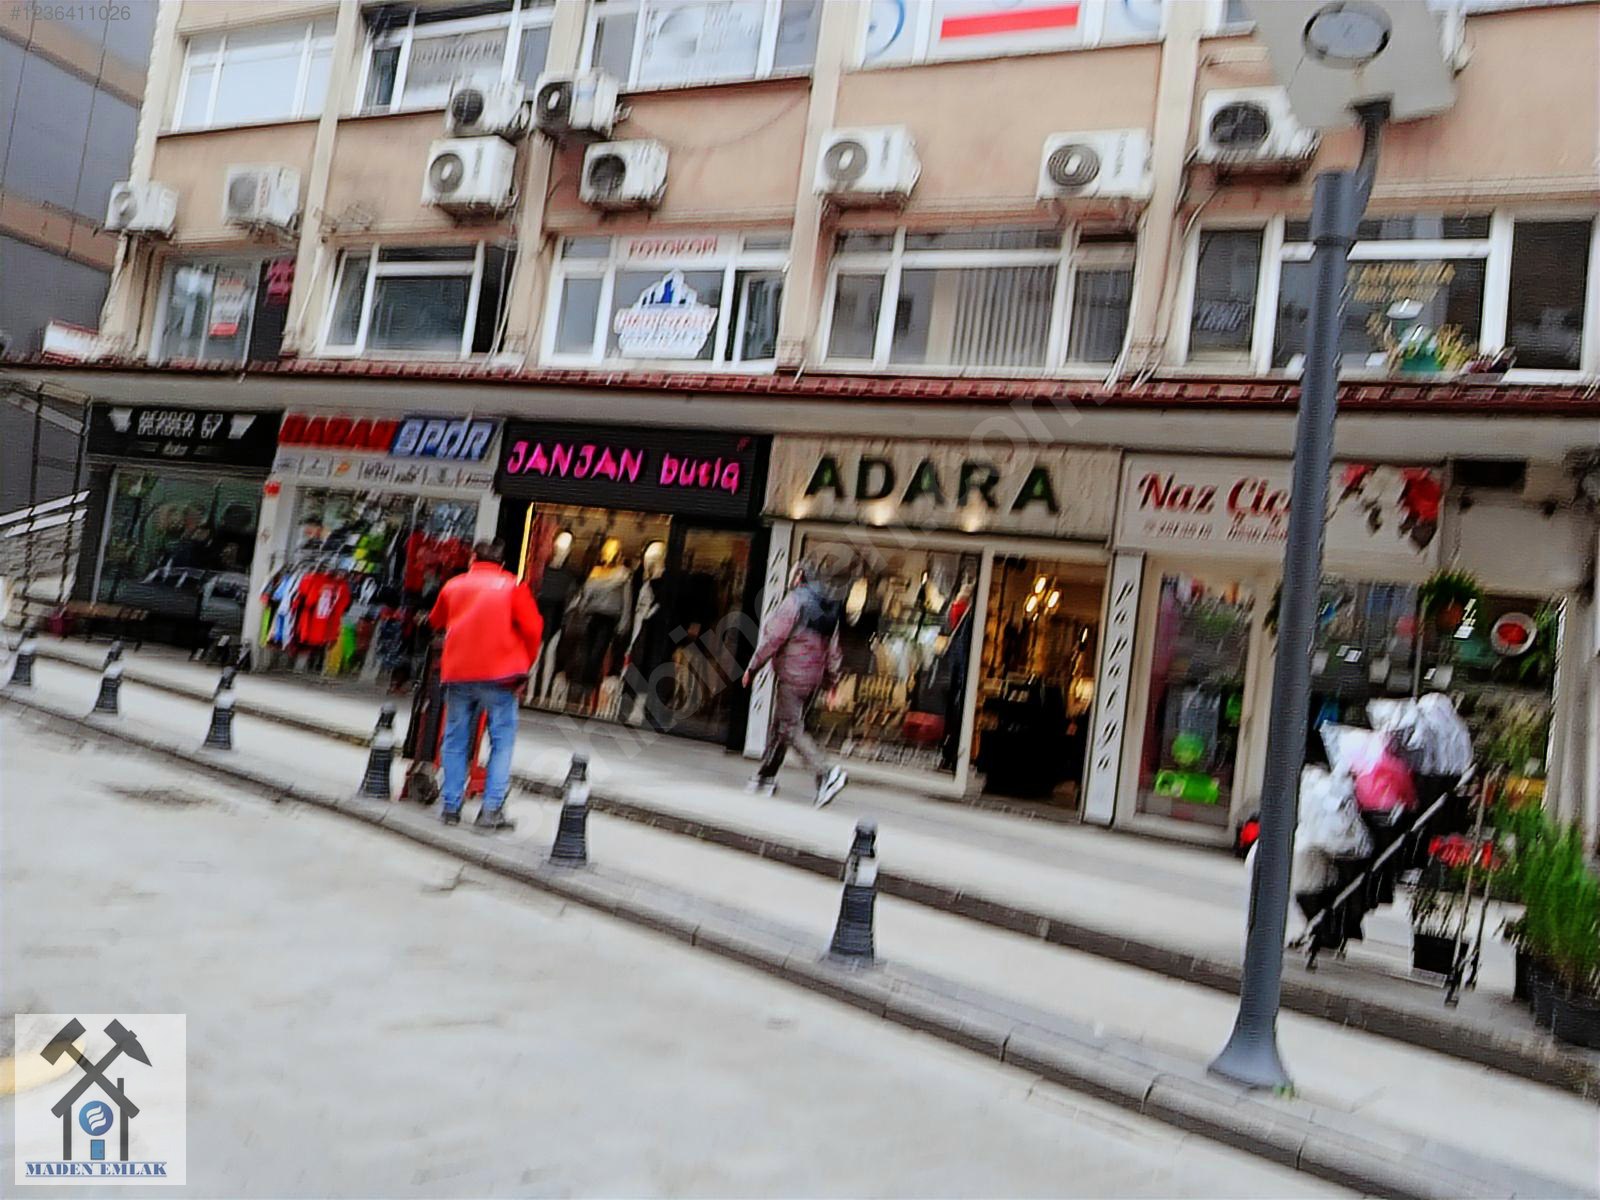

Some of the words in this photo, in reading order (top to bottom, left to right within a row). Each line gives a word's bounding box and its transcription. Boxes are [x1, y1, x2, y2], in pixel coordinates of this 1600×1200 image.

[506, 440, 644, 485] JANJAN
[802, 455, 1058, 514] ADARA
[1137, 471, 1218, 515] Naz
